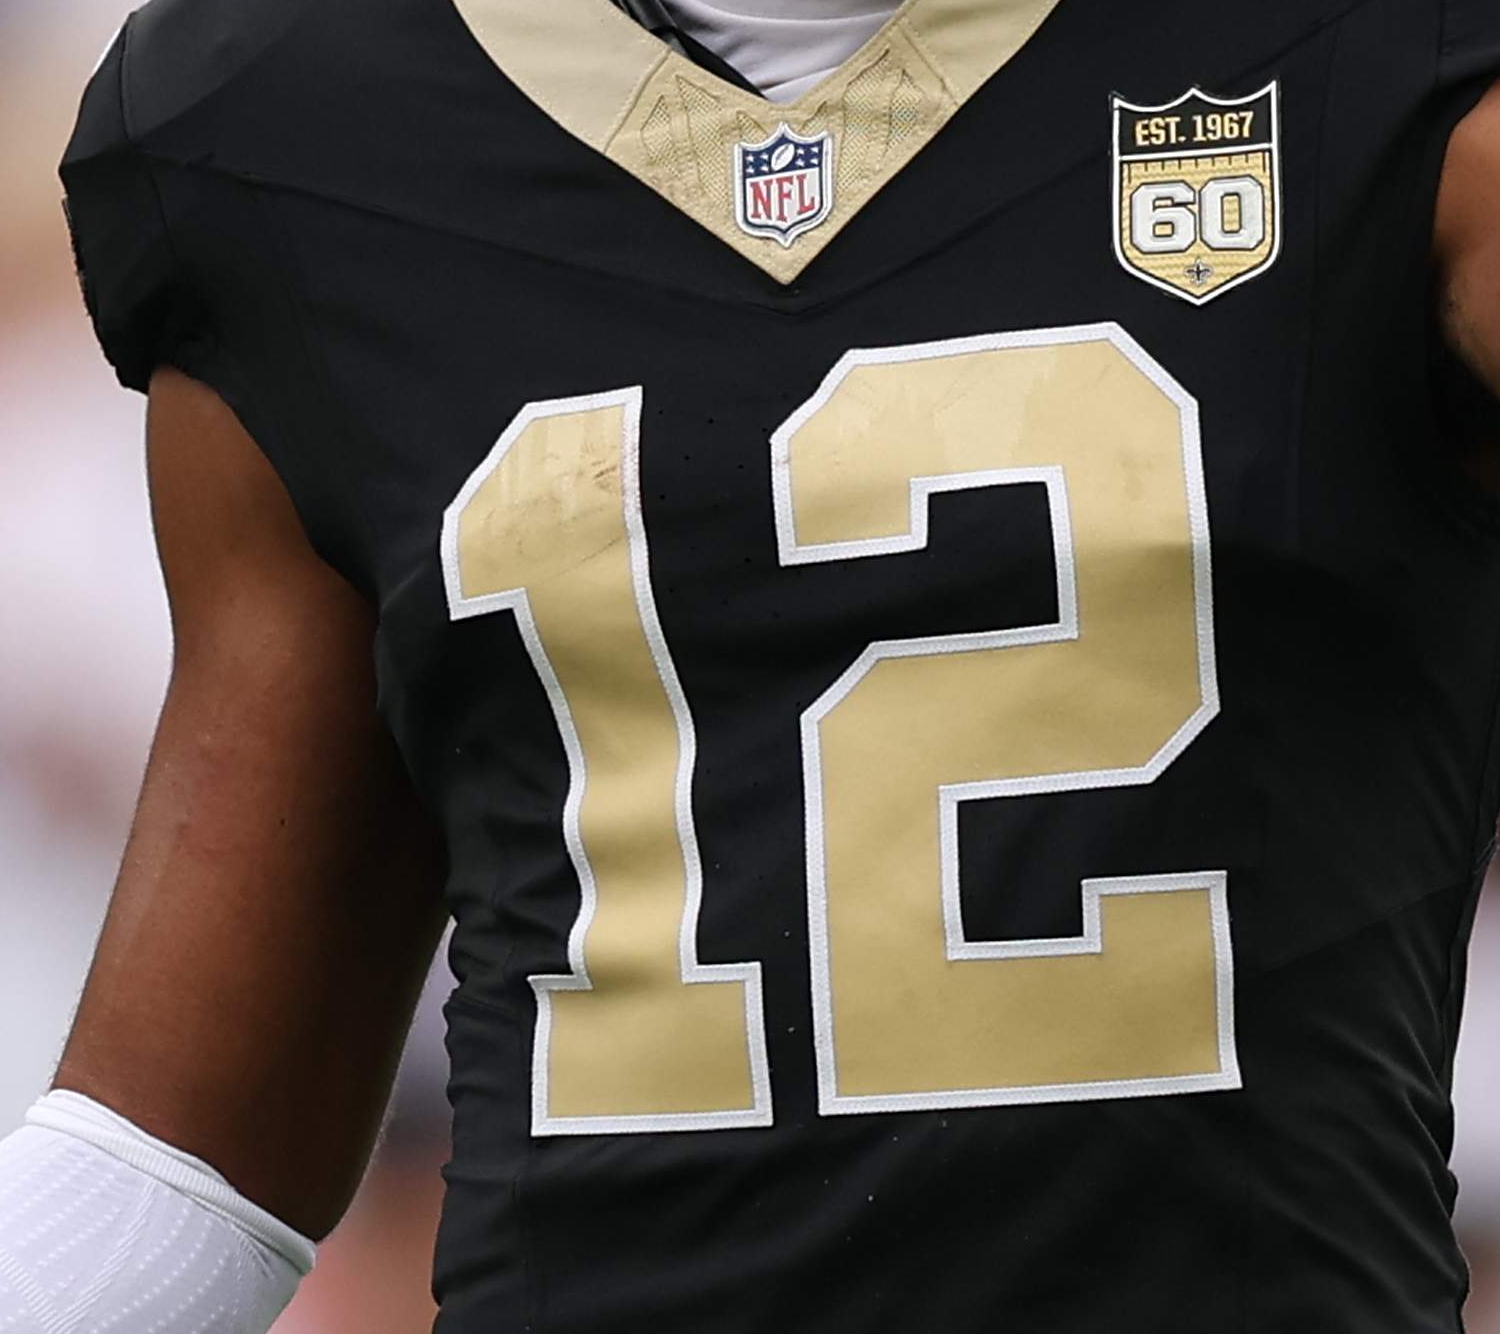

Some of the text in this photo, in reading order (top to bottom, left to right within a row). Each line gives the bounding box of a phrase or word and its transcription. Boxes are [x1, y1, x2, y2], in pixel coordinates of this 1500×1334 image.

[1135, 111, 1254, 146] EST. 1967
[750, 173, 815, 222] NFL
[1130, 175, 1266, 255] 60
[441, 322, 1242, 1136] 12
